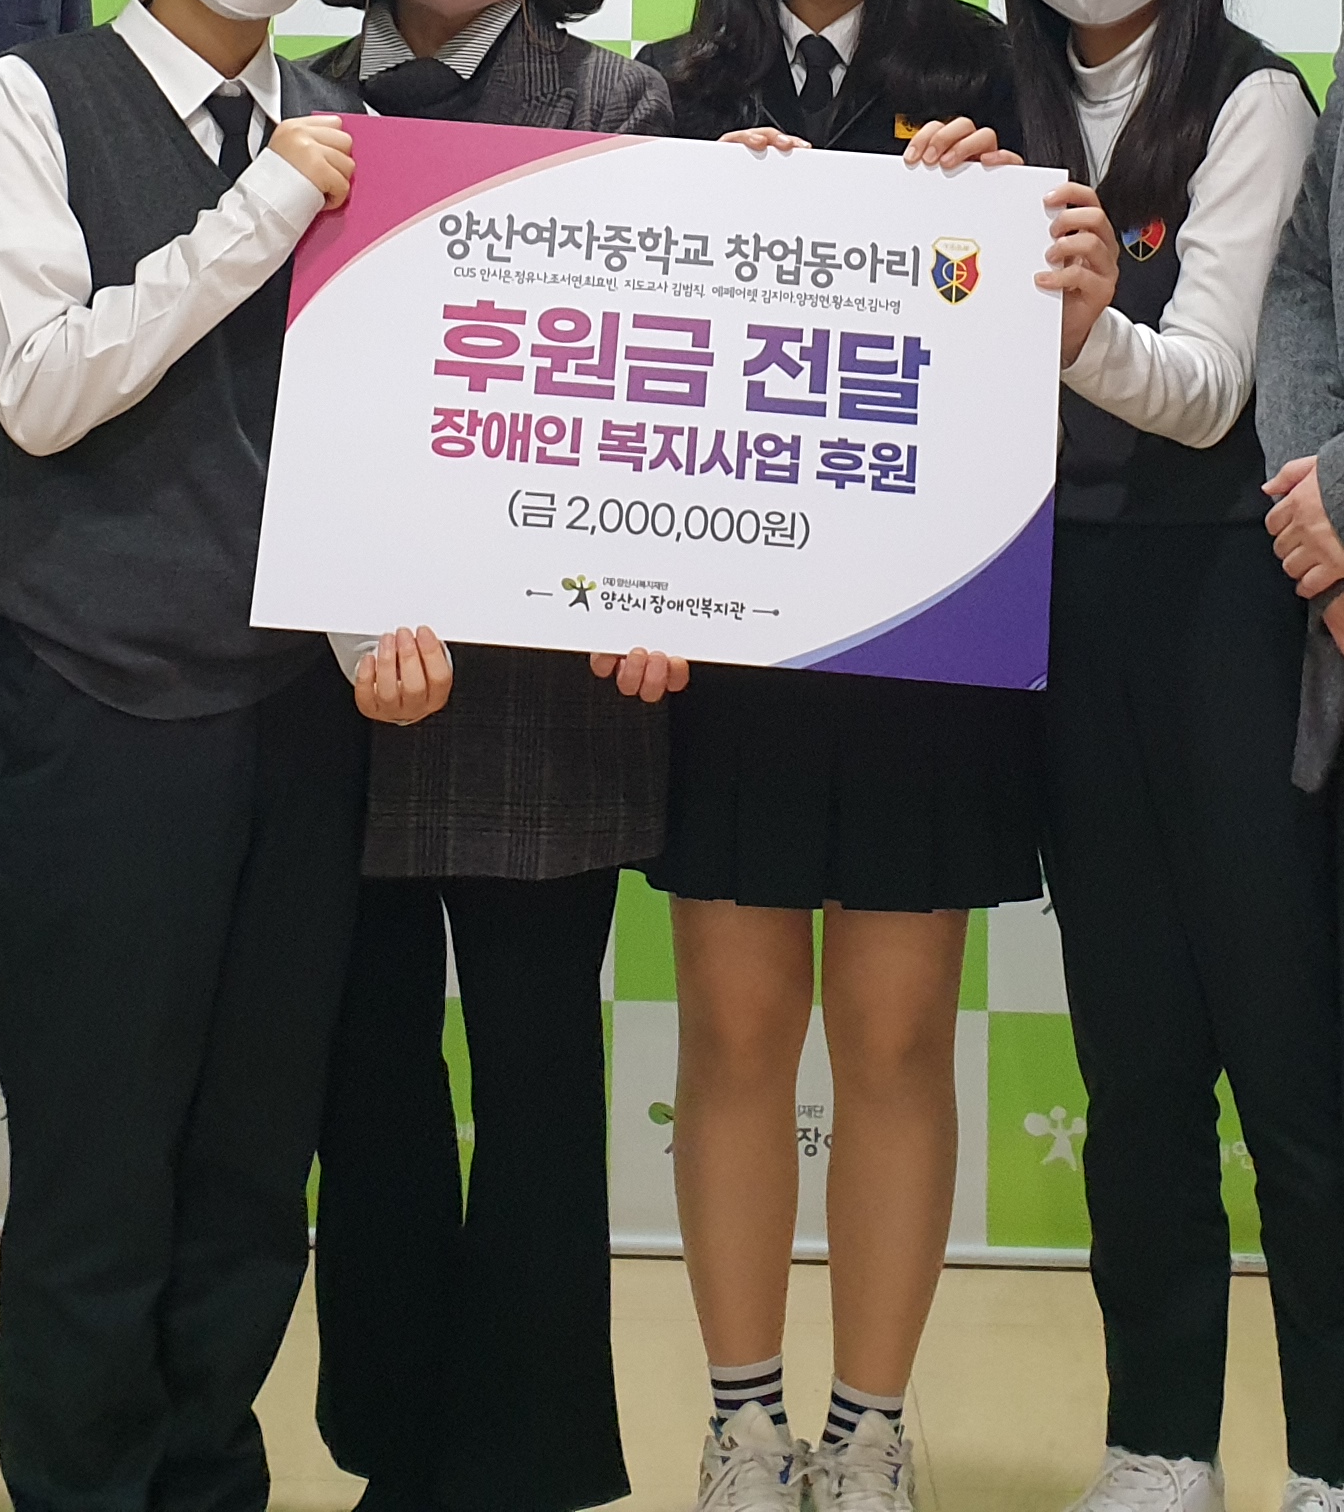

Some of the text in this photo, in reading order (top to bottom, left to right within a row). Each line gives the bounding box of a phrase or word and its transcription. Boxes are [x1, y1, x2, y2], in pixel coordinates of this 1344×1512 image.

[439, 210, 920, 289] 양산여자중학교 창업동아리
[453, 266, 477, 279] CUS
[624, 278, 668, 294] 지도교사
[434, 300, 931, 426] 후원금 전달
[429, 406, 918, 495] 장애인 복지사업 후원
[508, 489, 811, 550] (금 2,000,000원)
